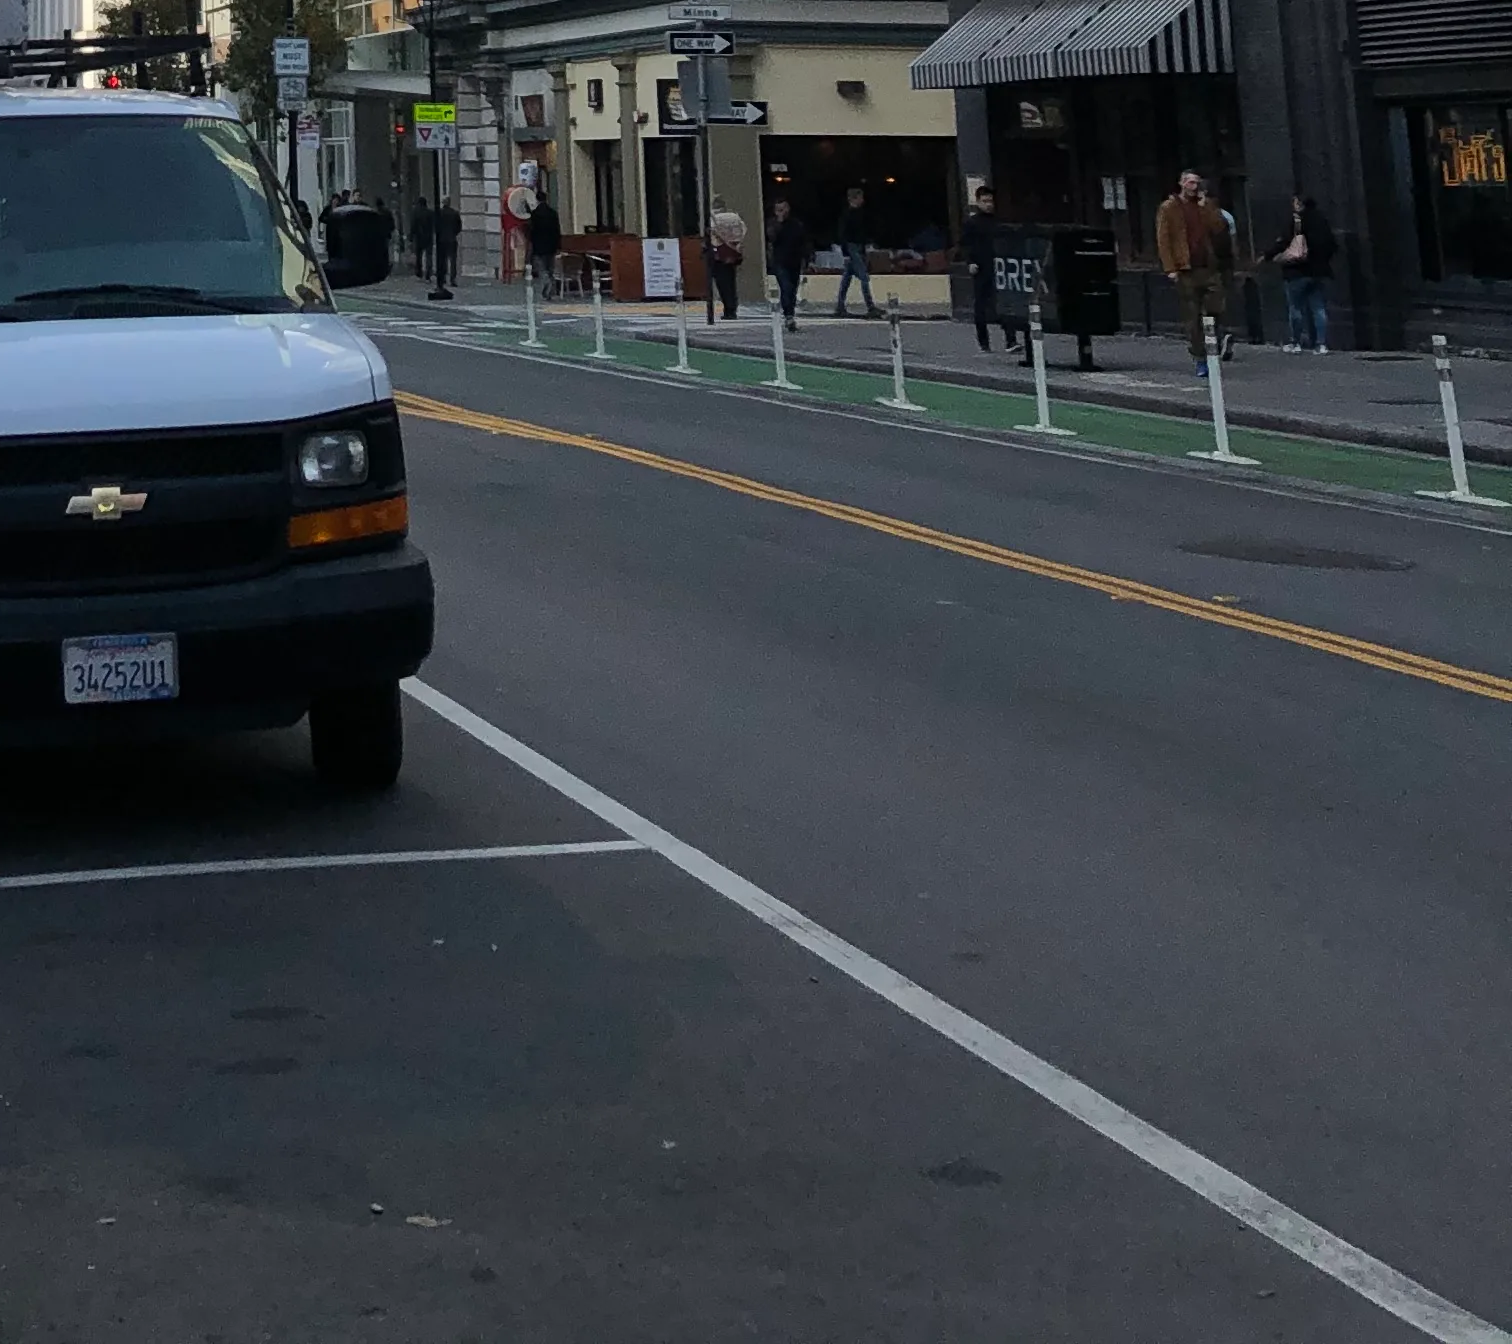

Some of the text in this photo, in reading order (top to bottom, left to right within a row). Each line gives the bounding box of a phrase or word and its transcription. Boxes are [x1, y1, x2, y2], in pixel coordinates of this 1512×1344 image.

[676, 39, 715, 48] ONE WAY
[731, 108, 747, 118] AY
[72, 659, 170, 693] 34252U1
